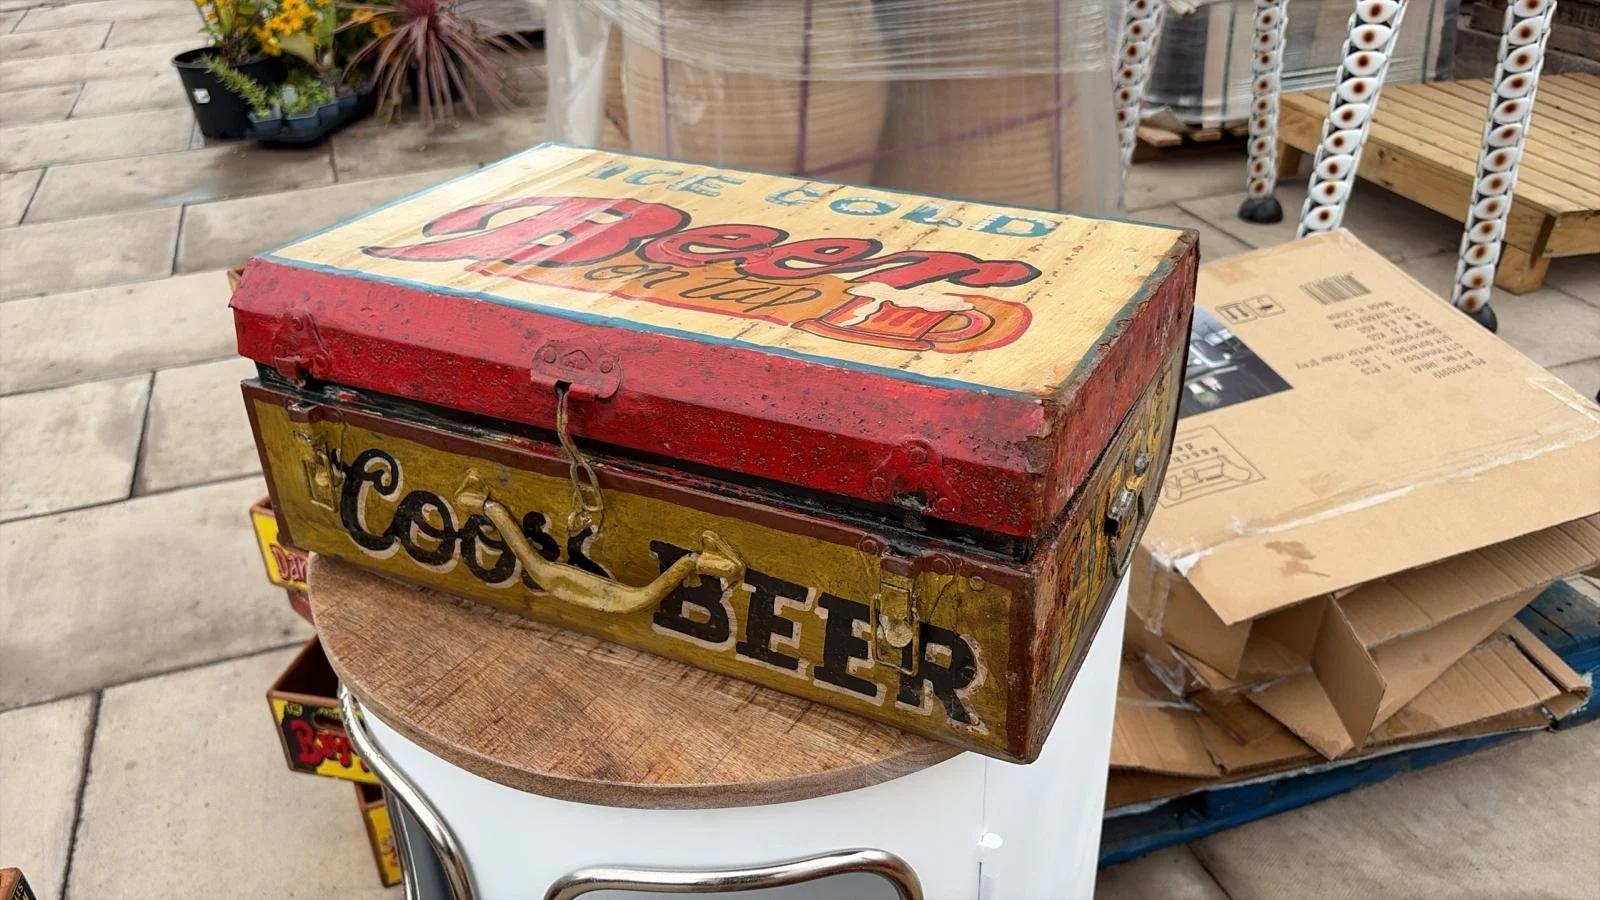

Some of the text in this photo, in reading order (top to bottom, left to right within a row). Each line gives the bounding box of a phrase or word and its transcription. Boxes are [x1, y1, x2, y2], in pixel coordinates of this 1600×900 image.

[361, 196, 1043, 288] Beer
[585, 163, 1060, 239] ICE COLD
[583, 264, 825, 313] on tap
[648, 540, 990, 736] BEER
